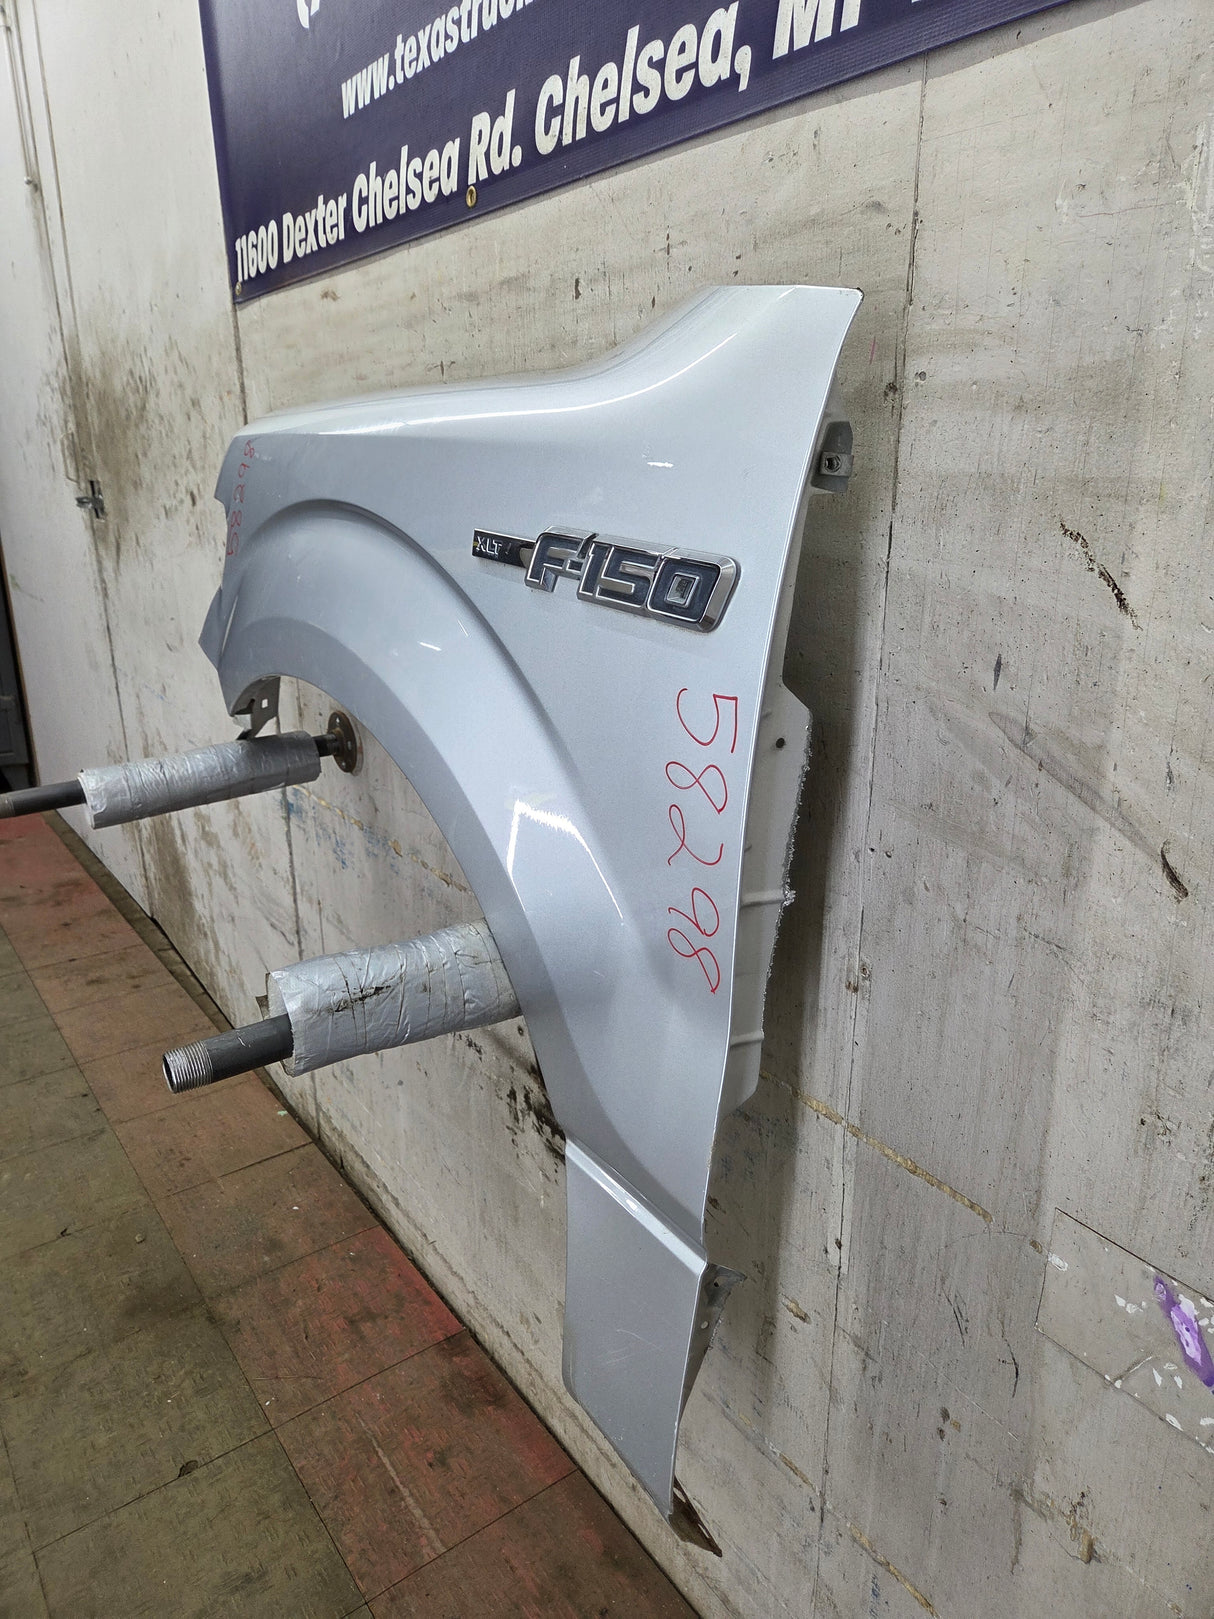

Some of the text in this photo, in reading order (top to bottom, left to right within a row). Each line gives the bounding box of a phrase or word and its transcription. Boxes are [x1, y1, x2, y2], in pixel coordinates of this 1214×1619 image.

[341, 0, 533, 119] www.texastru
[235, 219, 278, 282] 11600
[282, 192, 347, 264] Dexter
[352, 137, 460, 233] Chelsea
[467, 89, 522, 186] Rd.
[535, 1, 752, 156] Chelsea,
[227, 439, 255, 556] 58298
[475, 536, 503, 556] XLT
[525, 526, 741, 633] F-150
[665, 687, 739, 995] 58298
